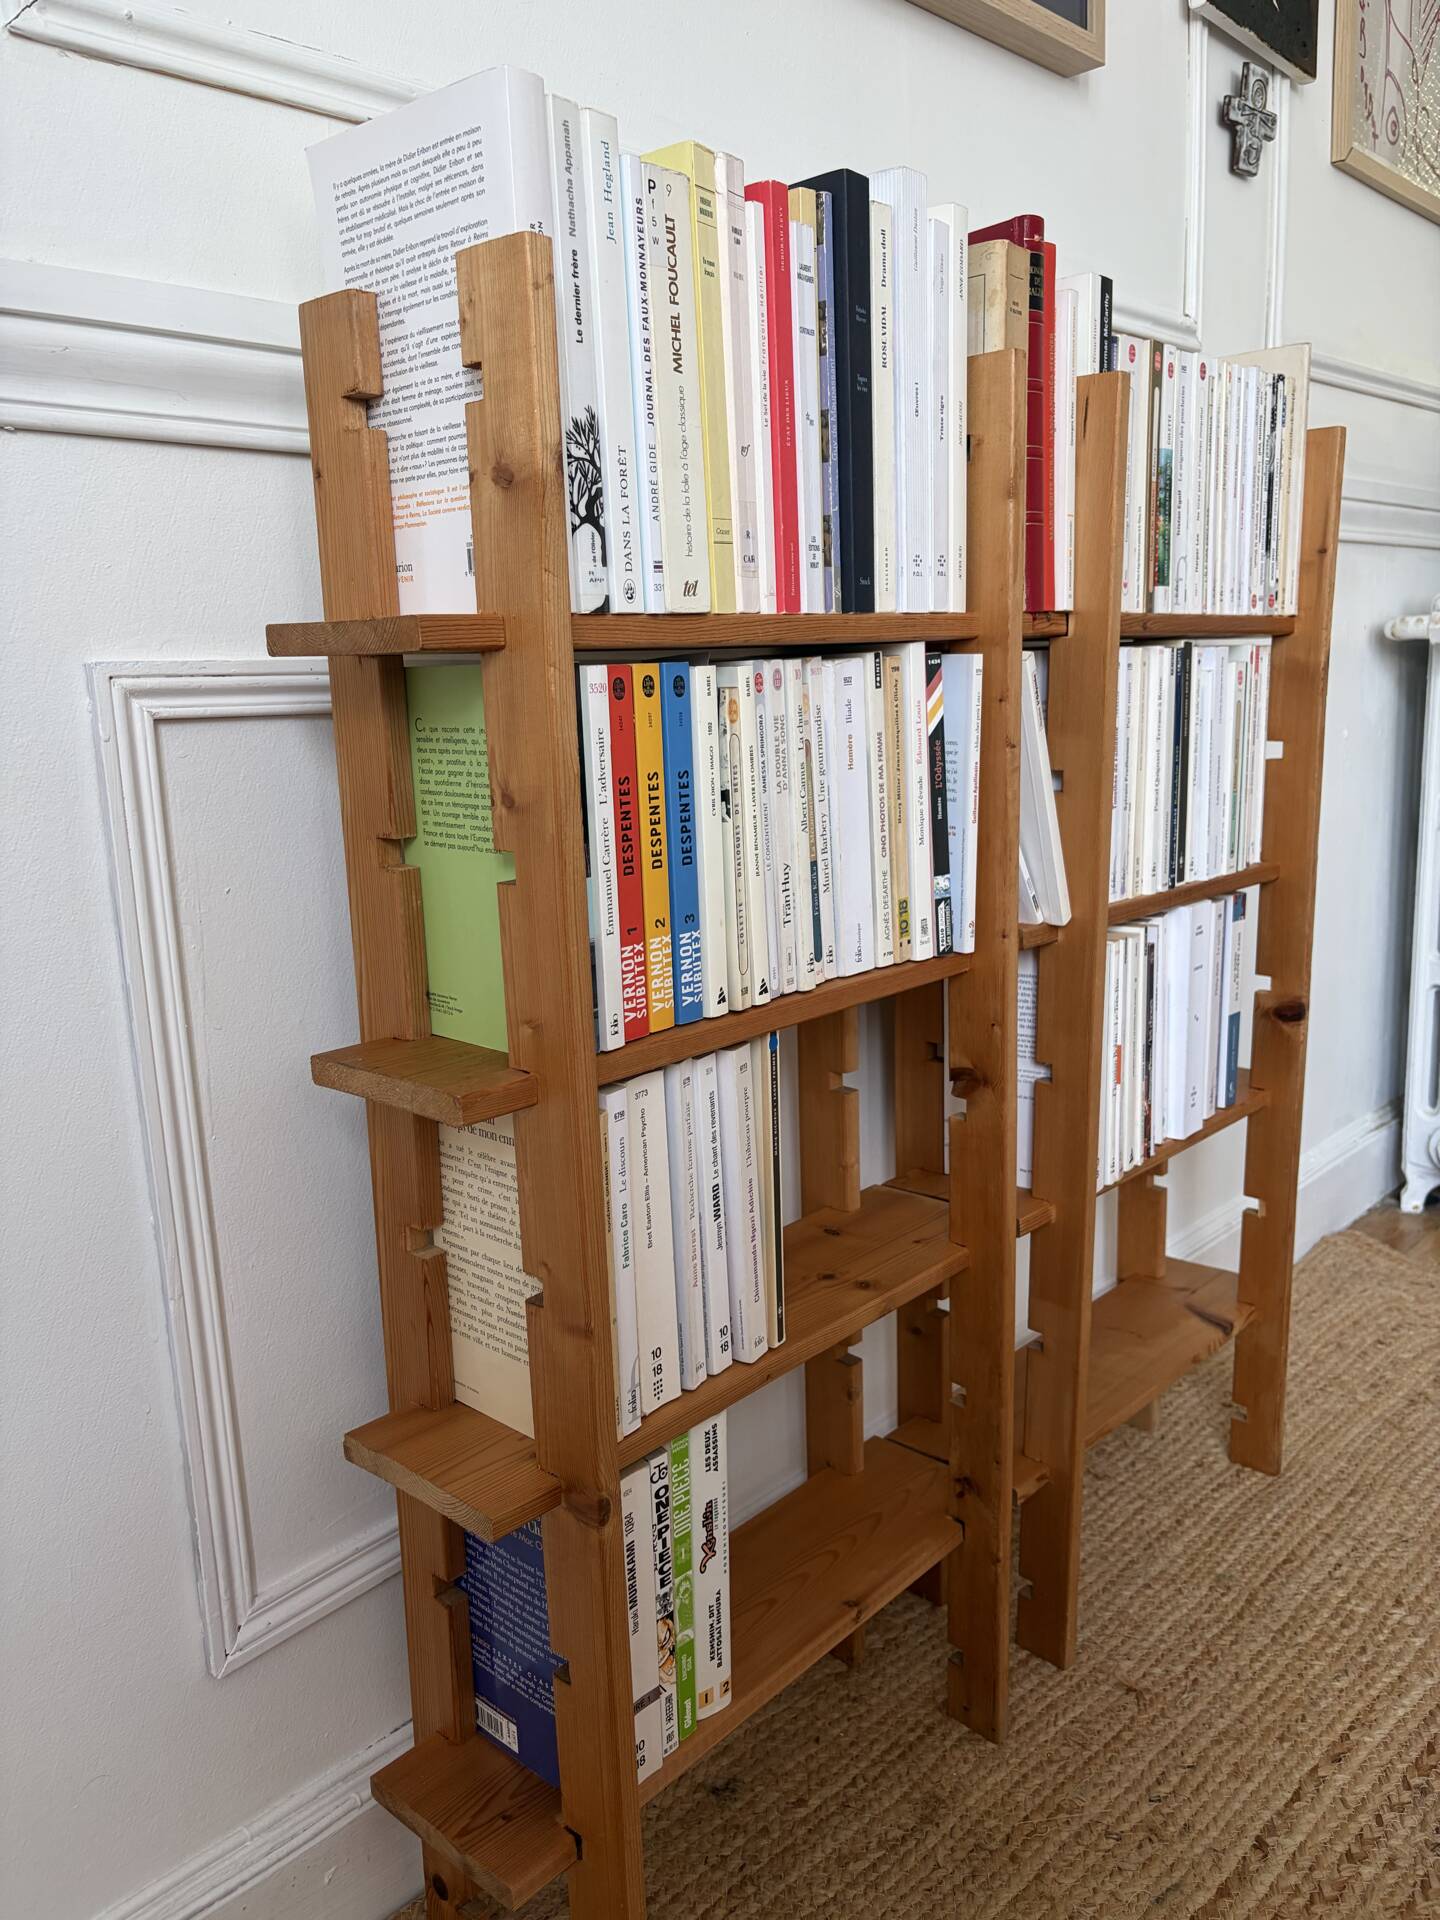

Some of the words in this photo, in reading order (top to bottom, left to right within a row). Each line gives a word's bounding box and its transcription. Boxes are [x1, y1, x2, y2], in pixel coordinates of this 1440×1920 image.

[403, 152, 416, 162] Didier
[462, 125, 481, 137] maison
[563, 119, 573, 175] Appanah
[601, 140, 613, 203] Hegland
[648, 179, 657, 194] P
[568, 178, 576, 237] Nathacha
[606, 211, 616, 243] Jean
[571, 249, 580, 278] frère
[635, 197, 649, 330] FAUX-MONNAYEURS
[665, 214, 679, 305] FOUCAULT
[574, 282, 582, 325] dernier
[575, 329, 583, 344] Le
[643, 338, 651, 361] DES
[671, 313, 683, 374] MICHEL
[644, 369, 655, 426] JOURNAL
[677, 386, 687, 433] classique
[618, 445, 629, 498] FORÊT
[648, 443, 657, 472] GIDE
[650, 478, 660, 521] ANDRÉ
[682, 474, 690, 493] folie
[684, 496, 691, 505] la
[622, 506, 630, 524] LA
[684, 507, 692, 522] de
[622, 531, 633, 572] DANS
[684, 524, 693, 556] histoire
[683, 580, 698, 597] tel
[589, 683, 607, 694] 3520
[798, 737, 804, 750] La
[814, 704, 826, 776] gourmandise
[596, 727, 608, 805] L'adversaire
[878, 764, 884, 780] MA
[934, 740, 943, 788] L'Odyssée
[776, 777, 782, 794] LA
[818, 780, 826, 803] Une
[879, 783, 885, 793] DE
[618, 776, 634, 876] DESPENTES
[647, 772, 662, 869] DESPENTES
[677, 770, 693, 865] DESPENTES
[800, 800, 808, 833] Albert
[879, 795, 887, 832] PHOTOS
[601, 818, 610, 865] Carrère
[819, 812, 828, 855] Barbery
[781, 862, 792, 893] Huy
[820, 858, 830, 893] Muriel
[881, 870, 889, 910] DESARTHE
[603, 869, 614, 936] Emmanuel
[684, 914, 695, 924] 3
[900, 900, 908, 915] 18
[655, 918, 665, 928] 2
[882, 911, 891, 940] AGNÈS
[900, 920, 909, 936] 10
[634, 942, 647, 1019] SUBUTEX
[649, 937, 665, 1013] VERNON
[662, 934, 674, 1009] SUBUTEX
[679, 932, 693, 1007] VERNON
[691, 929, 703, 1003] SUBUTEX
[621, 946, 636, 1023] VERNON
[610, 1013, 619, 1036] folio
[639, 1108, 648, 1137] Psycho
[708, 1091, 716, 1129] revenants
[479, 1128, 497, 1142] mon
[617, 1136, 626, 1177] discours
[710, 1145, 719, 1167] chant
[619, 1178, 627, 1192] Le
[712, 1169, 719, 1179] Le
[620, 1203, 628, 1228] Caro
[712, 1183, 722, 1222] WARD
[620, 1230, 630, 1269] Fabrice
[719, 1325, 728, 1338] 10
[720, 1341, 729, 1354] 18
[651, 1347, 661, 1360] 10
[652, 1364, 662, 1378] 18
[654, 1484, 669, 1524] ONE
[657, 1524, 671, 1589] PIECE
[626, 1540, 638, 1610] MURAKAMI
[723, 1681, 730, 1694] 2
